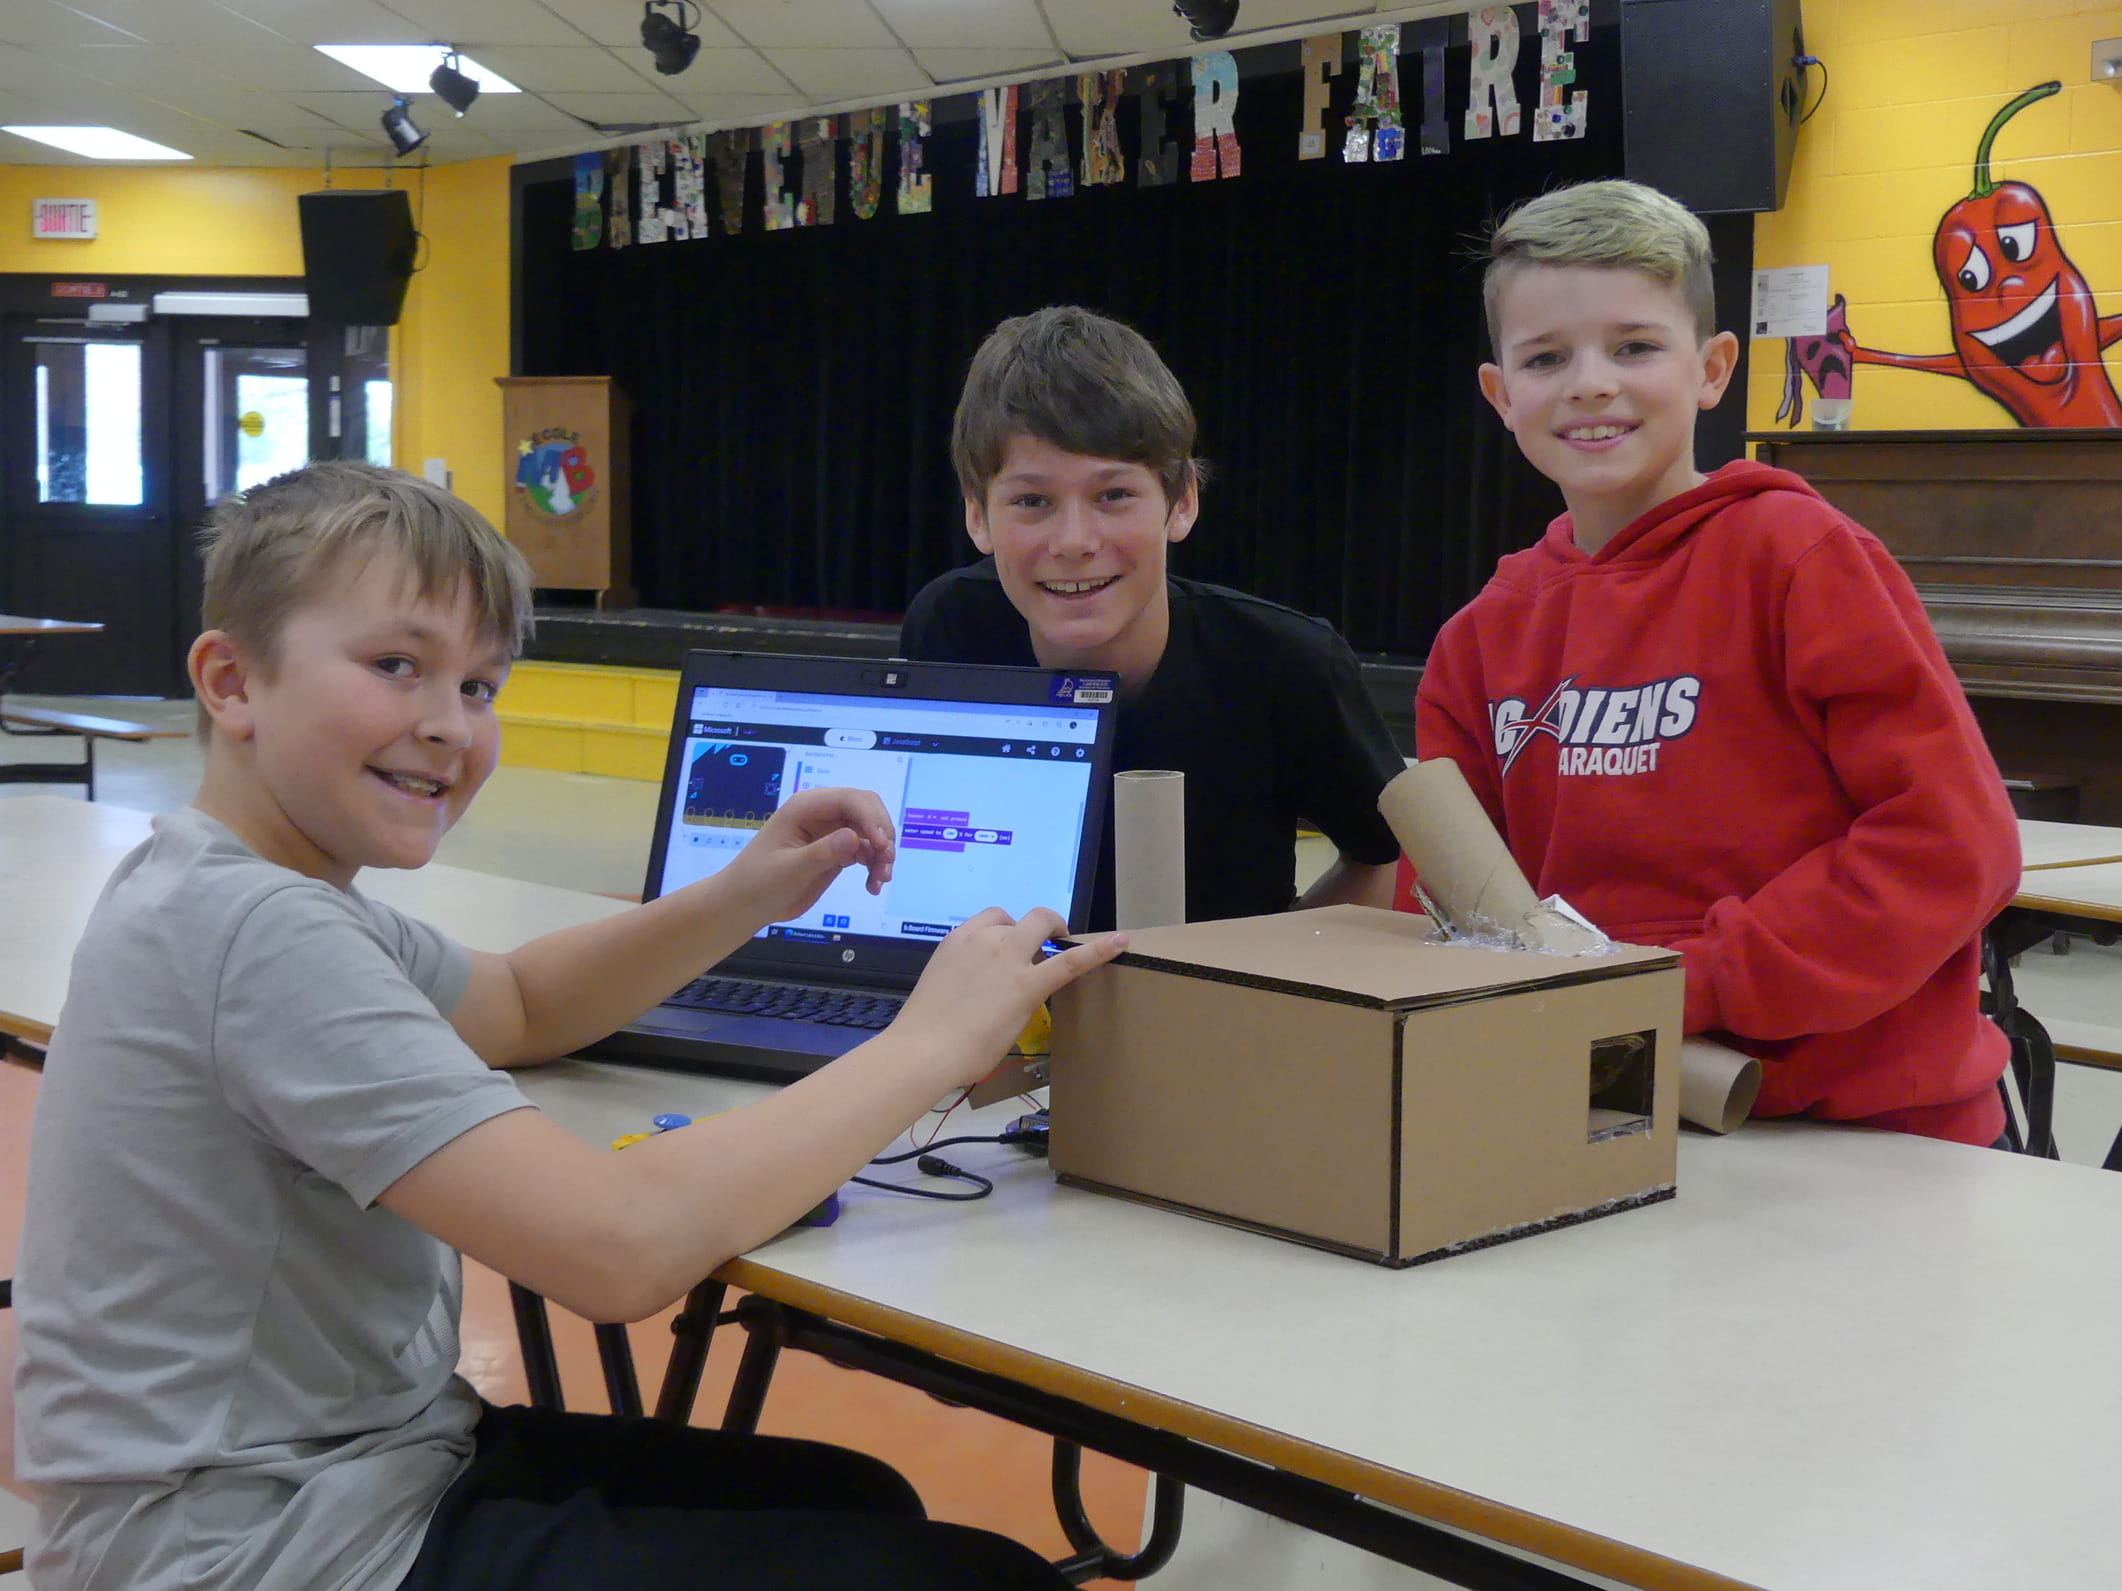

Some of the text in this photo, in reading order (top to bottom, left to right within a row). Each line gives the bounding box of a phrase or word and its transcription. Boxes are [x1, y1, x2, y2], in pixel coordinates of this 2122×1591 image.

[571, 98, 932, 252] BIENVENUE
[1298, 0, 1590, 164] FAIRE
[40, 204, 88, 233] SORTIE
[1488, 674, 1700, 778] CADIENS
[1558, 742, 1661, 776] ARAQUET
